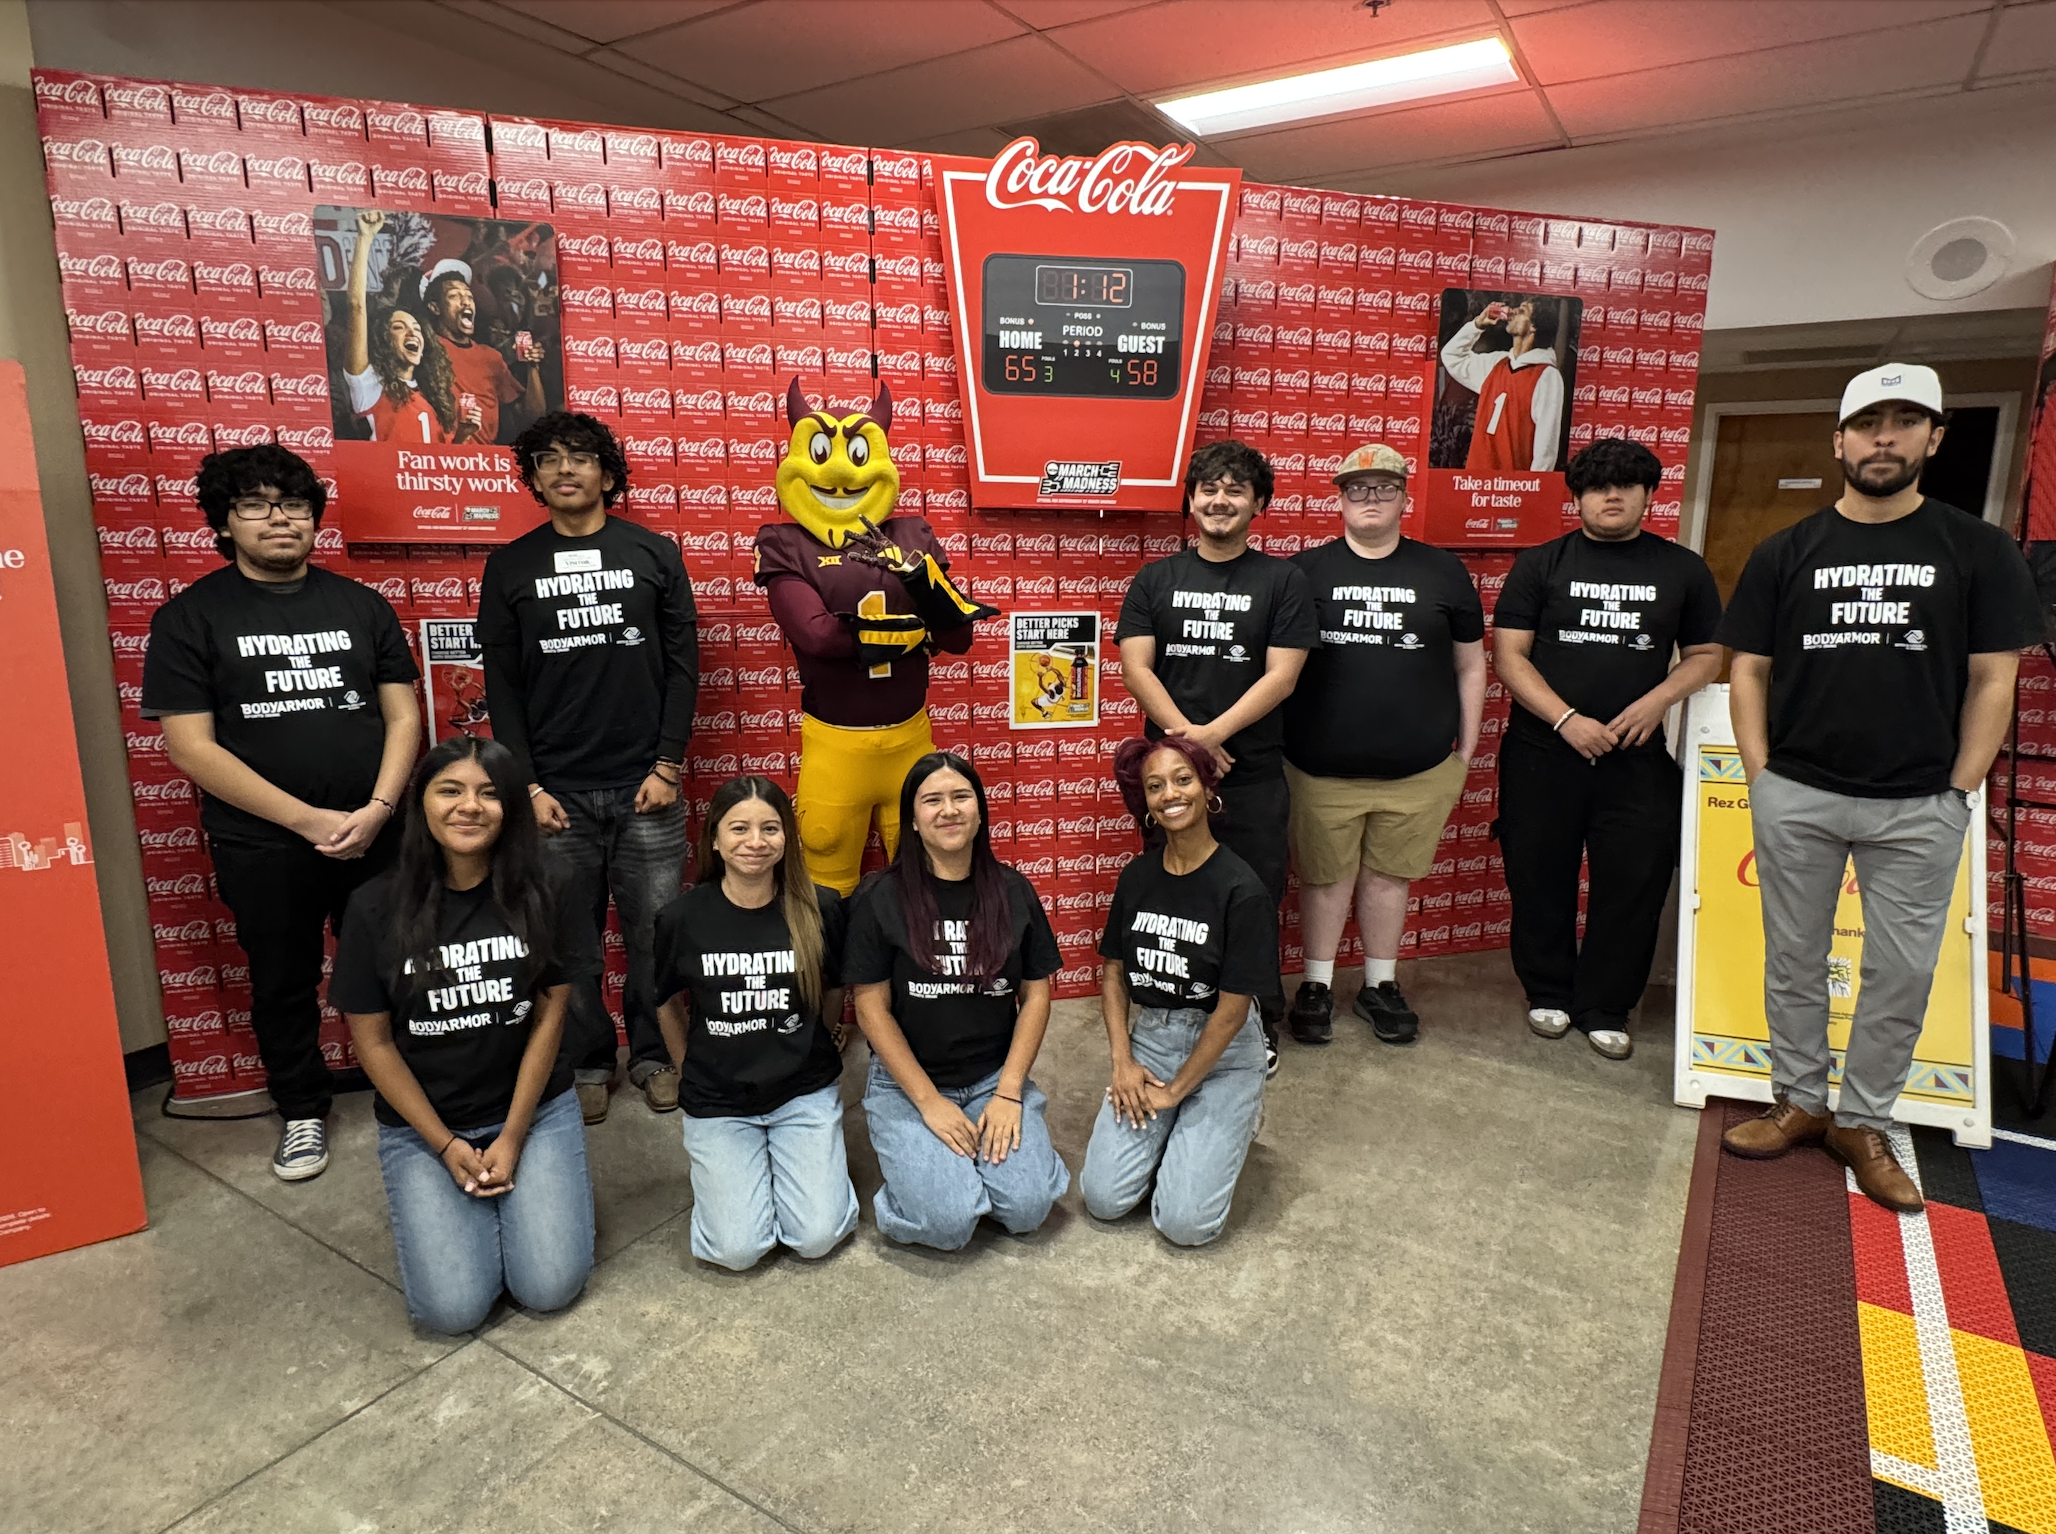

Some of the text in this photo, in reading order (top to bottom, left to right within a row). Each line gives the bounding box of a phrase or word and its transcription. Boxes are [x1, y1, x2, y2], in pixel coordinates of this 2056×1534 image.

[985, 140, 1194, 216] Coca-Cola
[1072, 273, 1127, 303] 1:12
[999, 316, 1025, 326] BONUS
[1074, 312, 1093, 320] POSS
[1062, 325, 1103, 337] PERIOD
[1140, 321, 1167, 331] BONUS
[999, 330, 1043, 350] HOME
[1117, 334, 1166, 354] GUEST
[1063, 349, 1068, 357] 1
[1096, 350, 1102, 358] 4
[1005, 355, 1037, 382] 65
[1044, 365, 1054, 383] 3
[1109, 369, 1121, 384] 4
[1127, 359, 1158, 386] 58
[1486, 392, 1508, 435] 1
[417, 412, 431, 443] 1
[397, 451, 511, 473] Fan work is
[1058, 464, 1100, 477] MARCH
[396, 472, 519, 496] thirsty work
[1063, 477, 1118, 490] MADNESS
[1452, 475, 1540, 492] Take a timeout
[1471, 493, 1522, 508] for taste
[535, 569, 635, 599] HYDRATING
[1813, 563, 1937, 590] HYDRATING
[577, 592, 599, 606] THE
[1172, 590, 1252, 612] HYDRATING
[1332, 585, 1416, 604] HYDRATING
[1569, 581, 1657, 602] HYDRATING
[1860, 587, 1885, 601] THE
[1203, 609, 1221, 621] THE
[1365, 601, 1383, 612] THE
[1602, 600, 1621, 612] THE
[1831, 601, 1911, 625] FUTURE
[556, 603, 625, 631] FUTURE
[1016, 617, 1080, 629] BETTER PICKS
[1342, 608, 1403, 631] FUTURE
[1580, 608, 1641, 630] FUTURE
[429, 624, 474, 637] BETTER
[1016, 629, 1070, 640] START HERE
[1182, 619, 1235, 641] FUTURE
[1320, 630, 1383, 645] BODYARMOR
[1558, 629, 1620, 645] BODYARMOR
[1802, 631, 1881, 646] BODYARMOR
[237, 629, 352, 657] HYDRATING
[430, 637, 468, 650] START
[538, 632, 607, 651] BODYARMOR
[1165, 643, 1216, 656] BODYARMOR
[288, 655, 313, 669] THE
[264, 665, 344, 693] FUTURE
[240, 697, 326, 716] BODYARMOR
[1707, 796, 1735, 809] Rez
[1131, 911, 1210, 945] HYDRATING
[1158, 936, 1177, 952] THE
[701, 950, 796, 977] HYDRATIN
[1136, 946, 1191, 979] FUTURE
[455, 965, 483, 983] THE
[744, 975, 767, 990] THE
[427, 977, 514, 1013] FUTURE
[908, 980, 975, 995] BODYARMOR
[720, 988, 791, 1014] FUTURE
[408, 1012, 492, 1034] BODYARMOR
[706, 1016, 768, 1036] ODYARMOR
